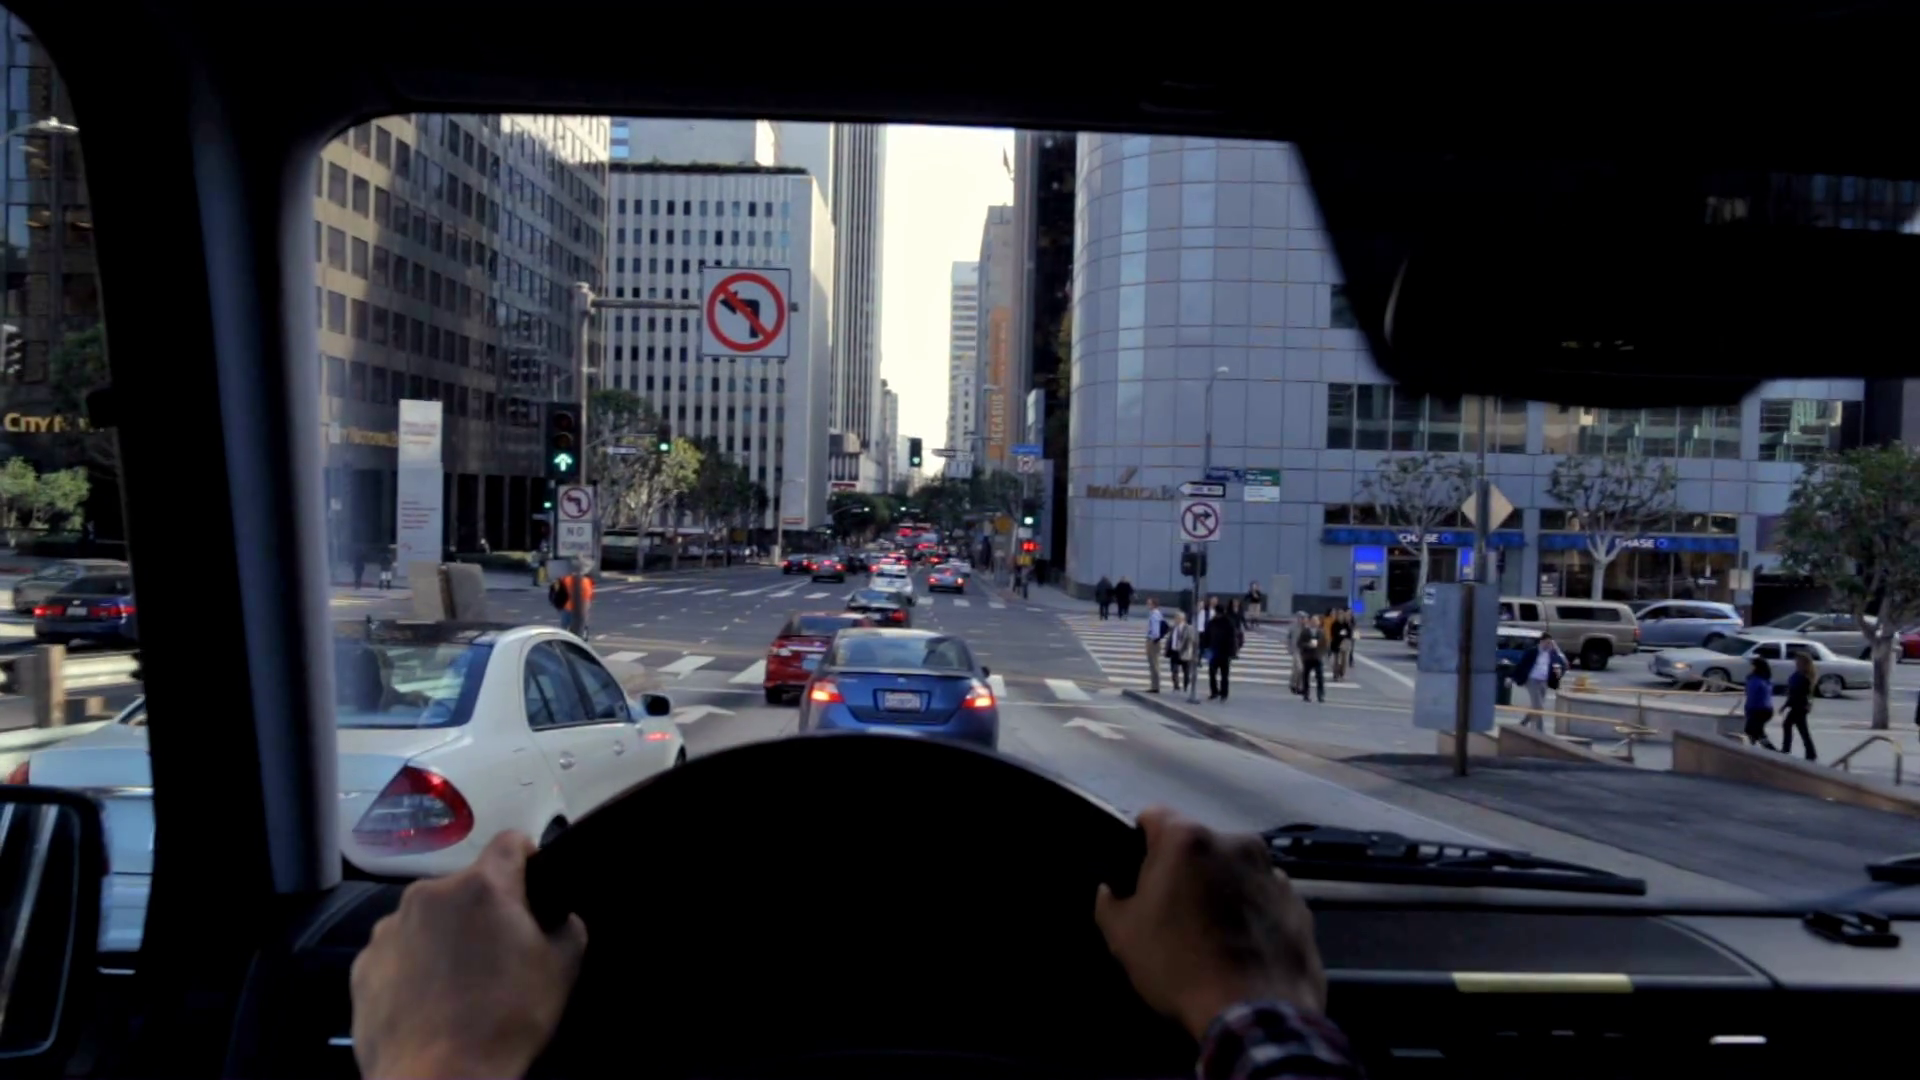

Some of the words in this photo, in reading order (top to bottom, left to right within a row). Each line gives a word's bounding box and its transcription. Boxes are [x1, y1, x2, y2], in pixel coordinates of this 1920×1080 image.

[3, 412, 50, 432] CITY
[566, 527, 585, 537] NO
[1399, 533, 1439, 543] CHSE
